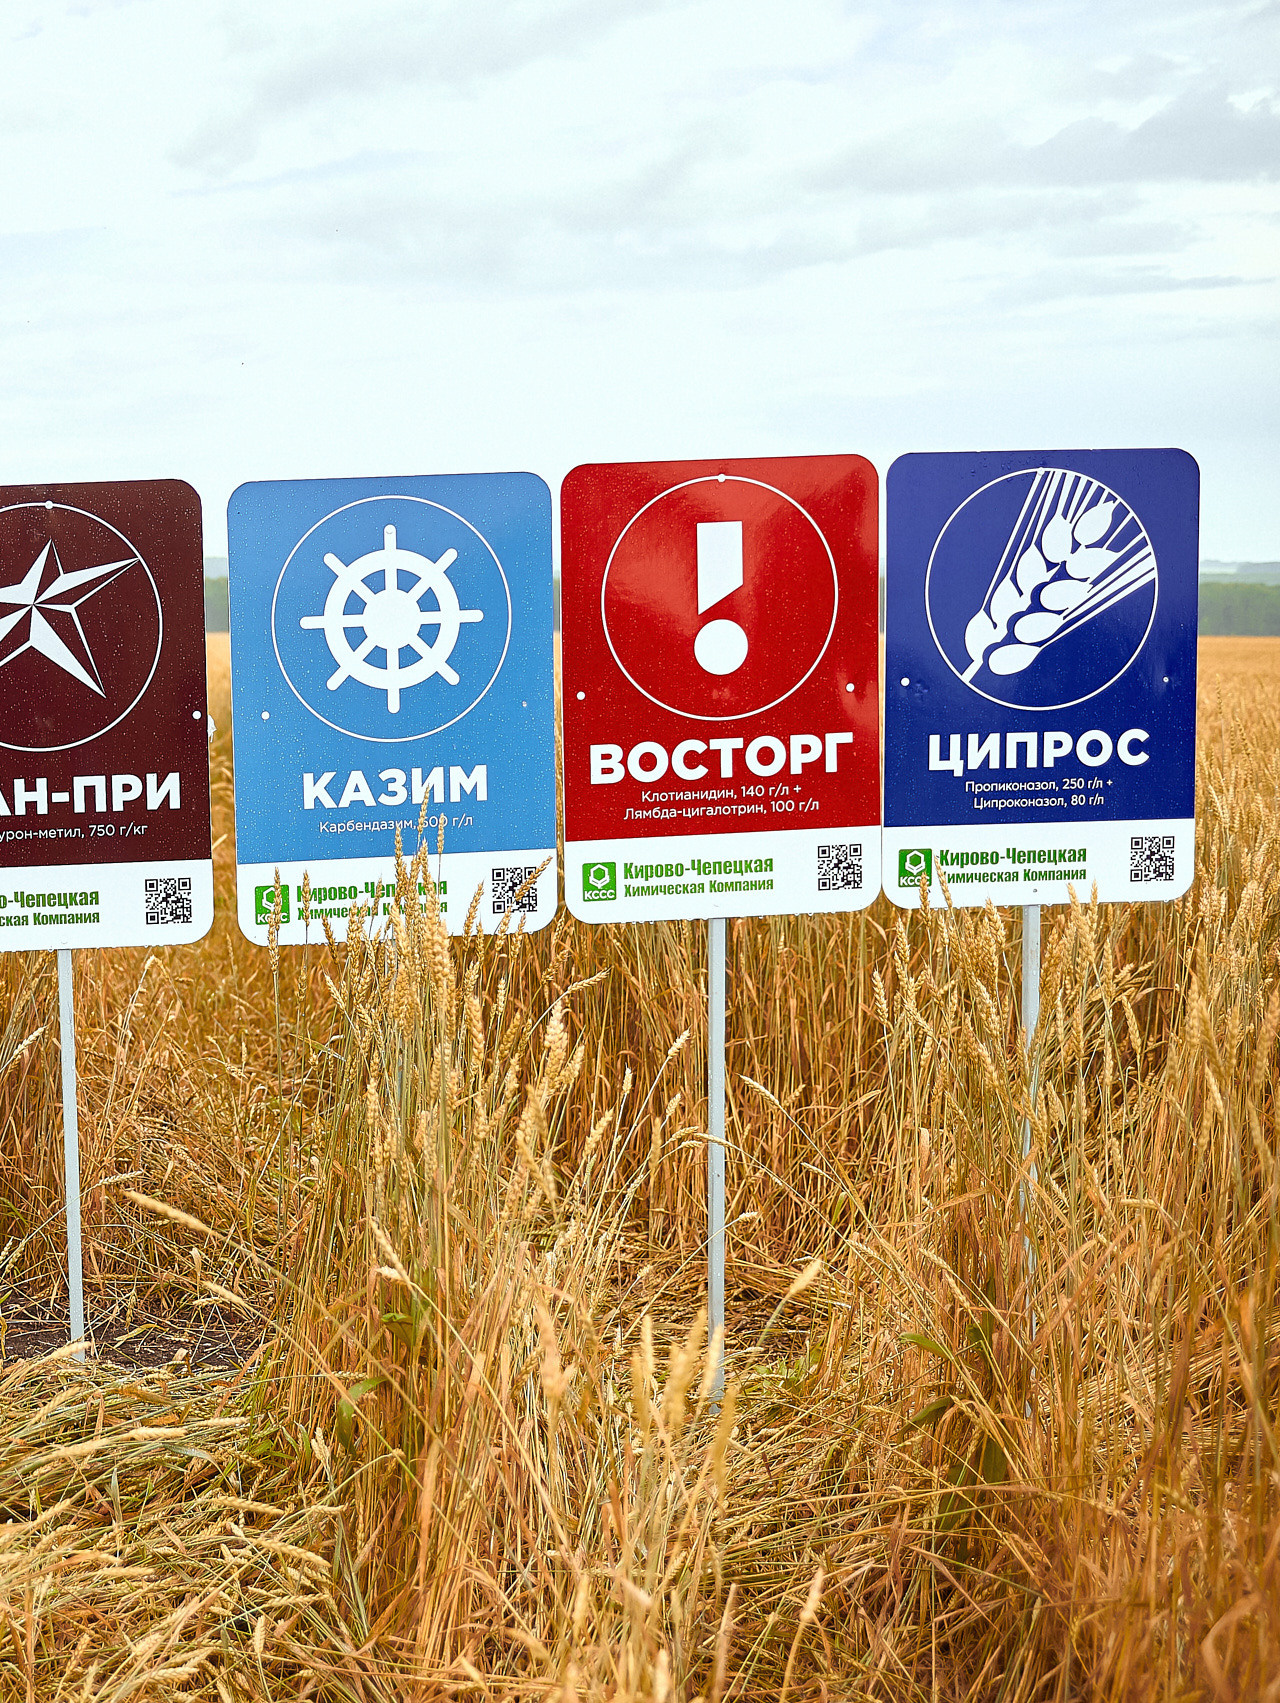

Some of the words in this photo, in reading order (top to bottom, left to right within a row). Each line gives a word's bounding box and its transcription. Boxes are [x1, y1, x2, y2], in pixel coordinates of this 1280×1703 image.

[590, 731, 853, 785] ВОСТОРГ
[928, 728, 1150, 777] ЦИПРОС
[303, 764, 488, 810] КАЗИМ
[641, 787, 737, 803] Клотианидин,
[741, 785, 765, 797] 140
[769, 783, 789, 796] г/л
[965, 781, 1059, 794] Пропиконазол,
[1062, 778, 1085, 790] 250
[1087, 777, 1103, 789] г/л
[624, 804, 767, 820] Лямбда-цигалотрин,
[770, 801, 795, 812] 100
[799, 798, 819, 812] г/л
[973, 797, 1067, 810] Ципроконазол,
[1070, 794, 1086, 806] 80
[1089, 793, 1104, 806] г/л
[89, 824, 115, 837] 750
[120, 822, 148, 837] г/кг
[319, 819, 417, 834] Карбендазим,
[452, 813, 473, 828] г/л
[939, 848, 1087, 868] Кирово-Чепецкая
[623, 858, 774, 880] Кирово-Чепецкая
[944, 871, 1019, 884] имическая
[1023, 869, 1087, 882] Компания
[624, 882, 705, 897] Химическая
[709, 878, 774, 894] Компания
[33, 912, 100, 925] Компания
